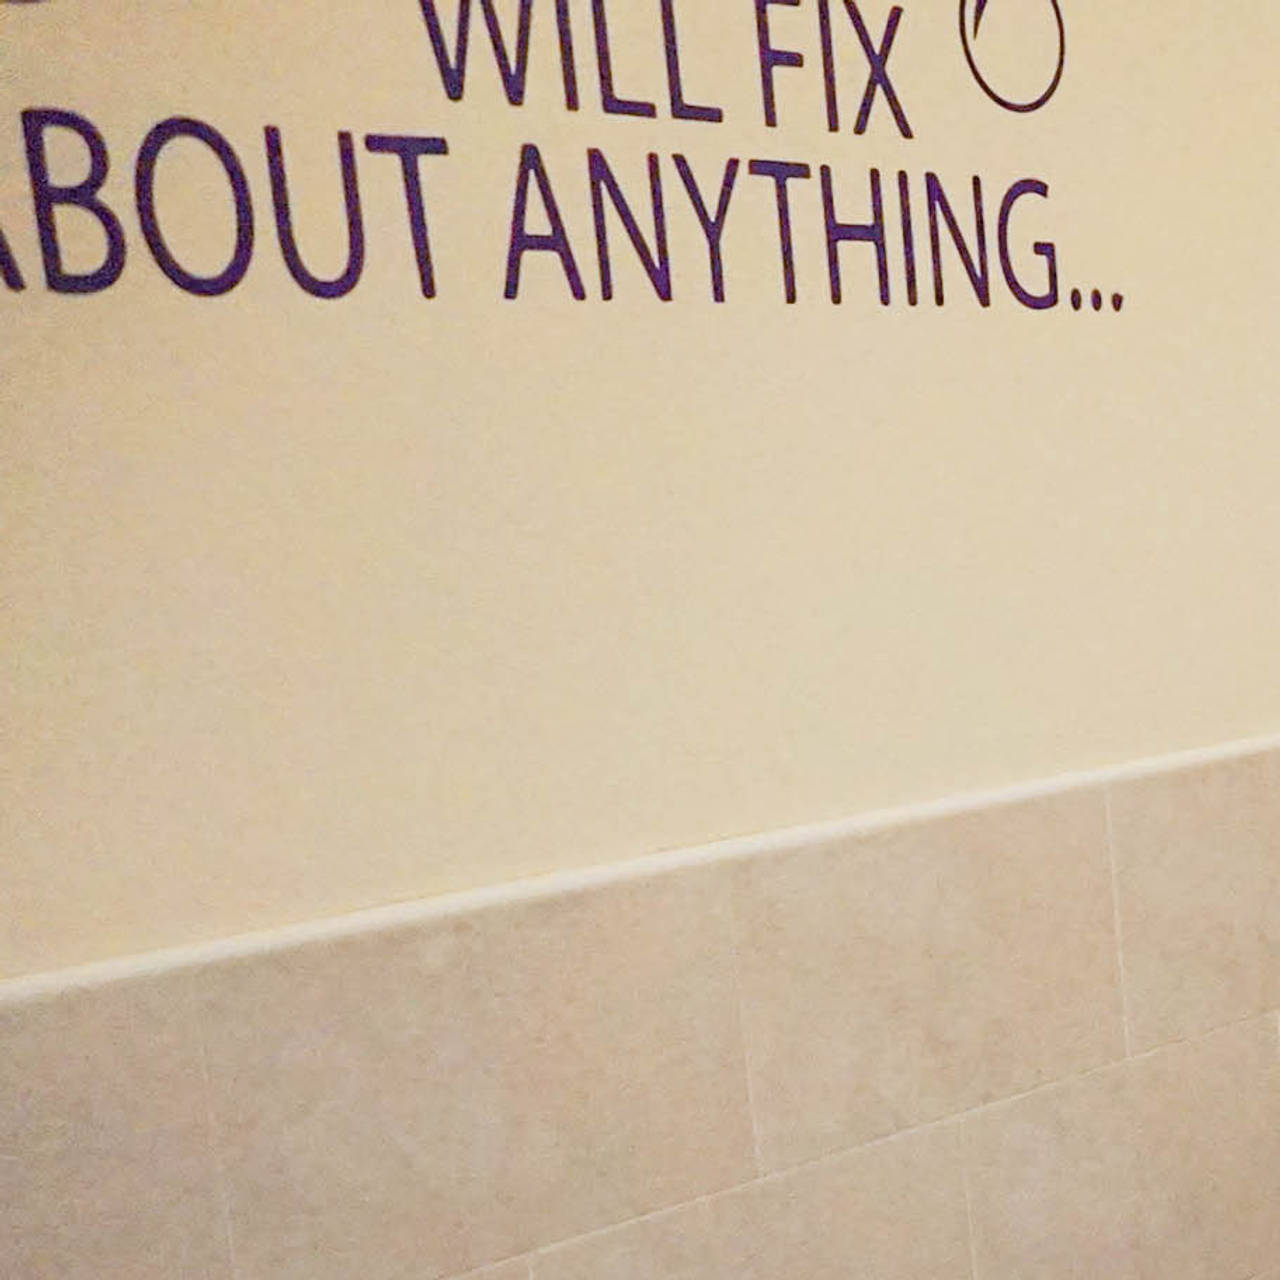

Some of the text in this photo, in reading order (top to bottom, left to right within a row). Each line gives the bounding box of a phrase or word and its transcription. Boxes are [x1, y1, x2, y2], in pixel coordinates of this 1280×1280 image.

[419, 0, 914, 140] WILL FIX
[0, 107, 1124, 312] BOUT ANYTHING...
